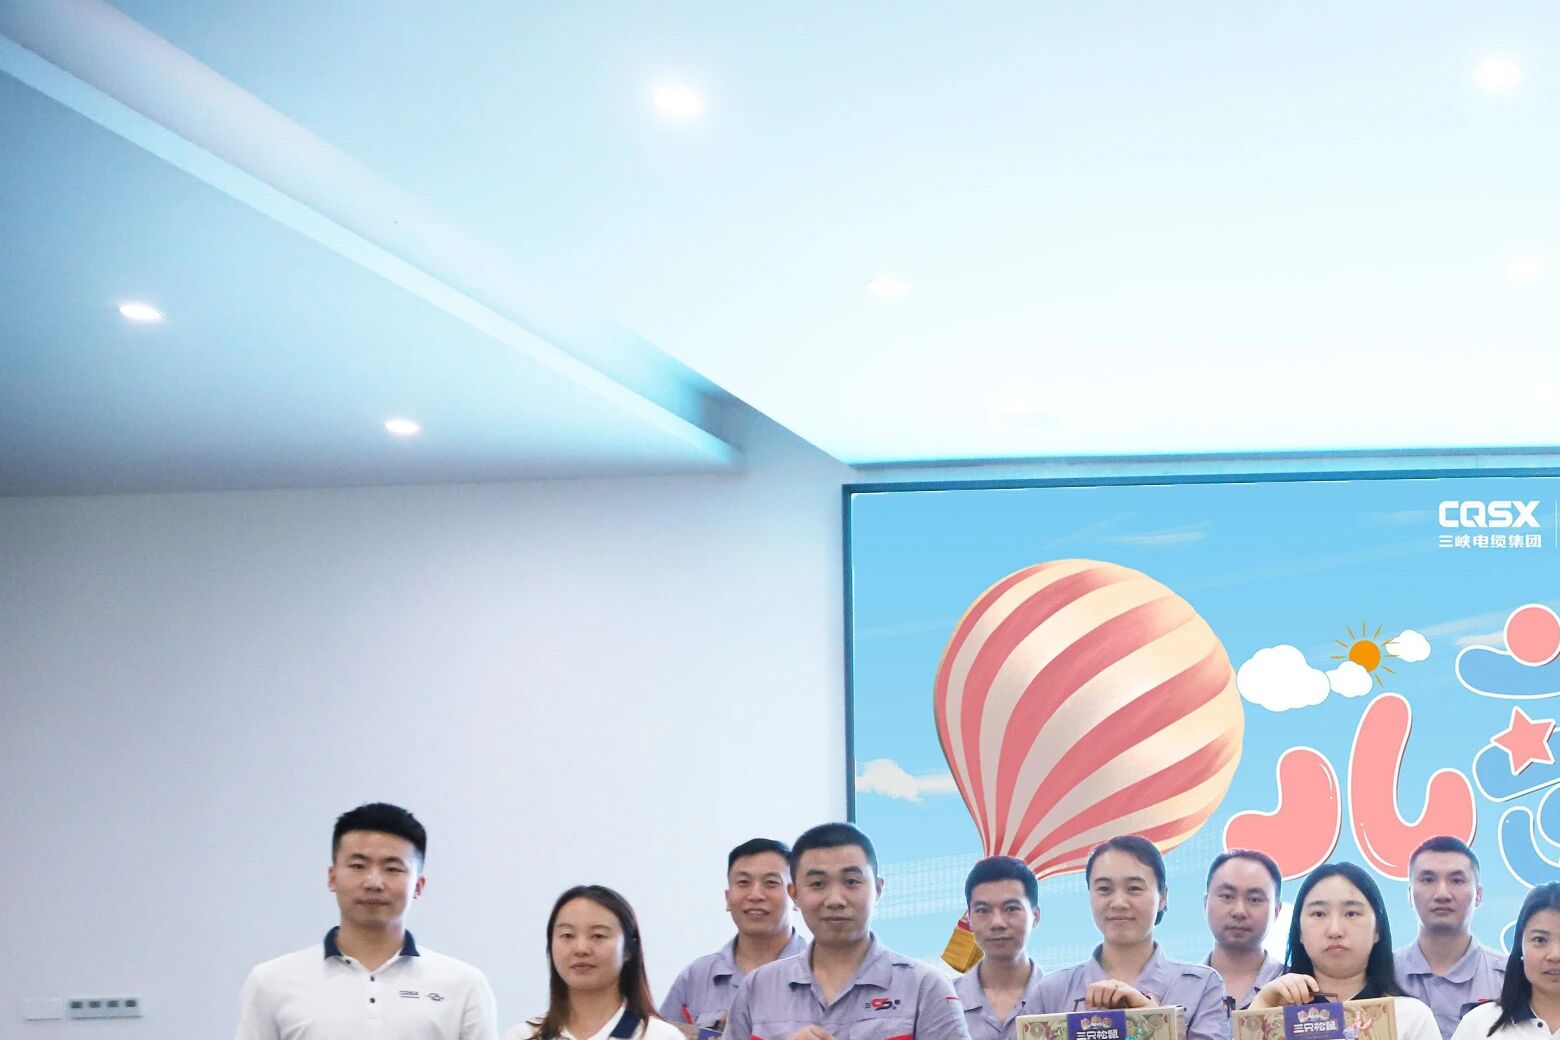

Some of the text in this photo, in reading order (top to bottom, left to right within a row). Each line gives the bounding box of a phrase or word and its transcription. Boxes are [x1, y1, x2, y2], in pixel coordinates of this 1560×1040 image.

[1438, 500, 1541, 528] CQSX
[1438, 534, 1542, 548] 三峡电缆集团
[1293, 1020, 1337, 1034] 三只松鼠
[1076, 1029, 1119, 1040] 三只松鼠
